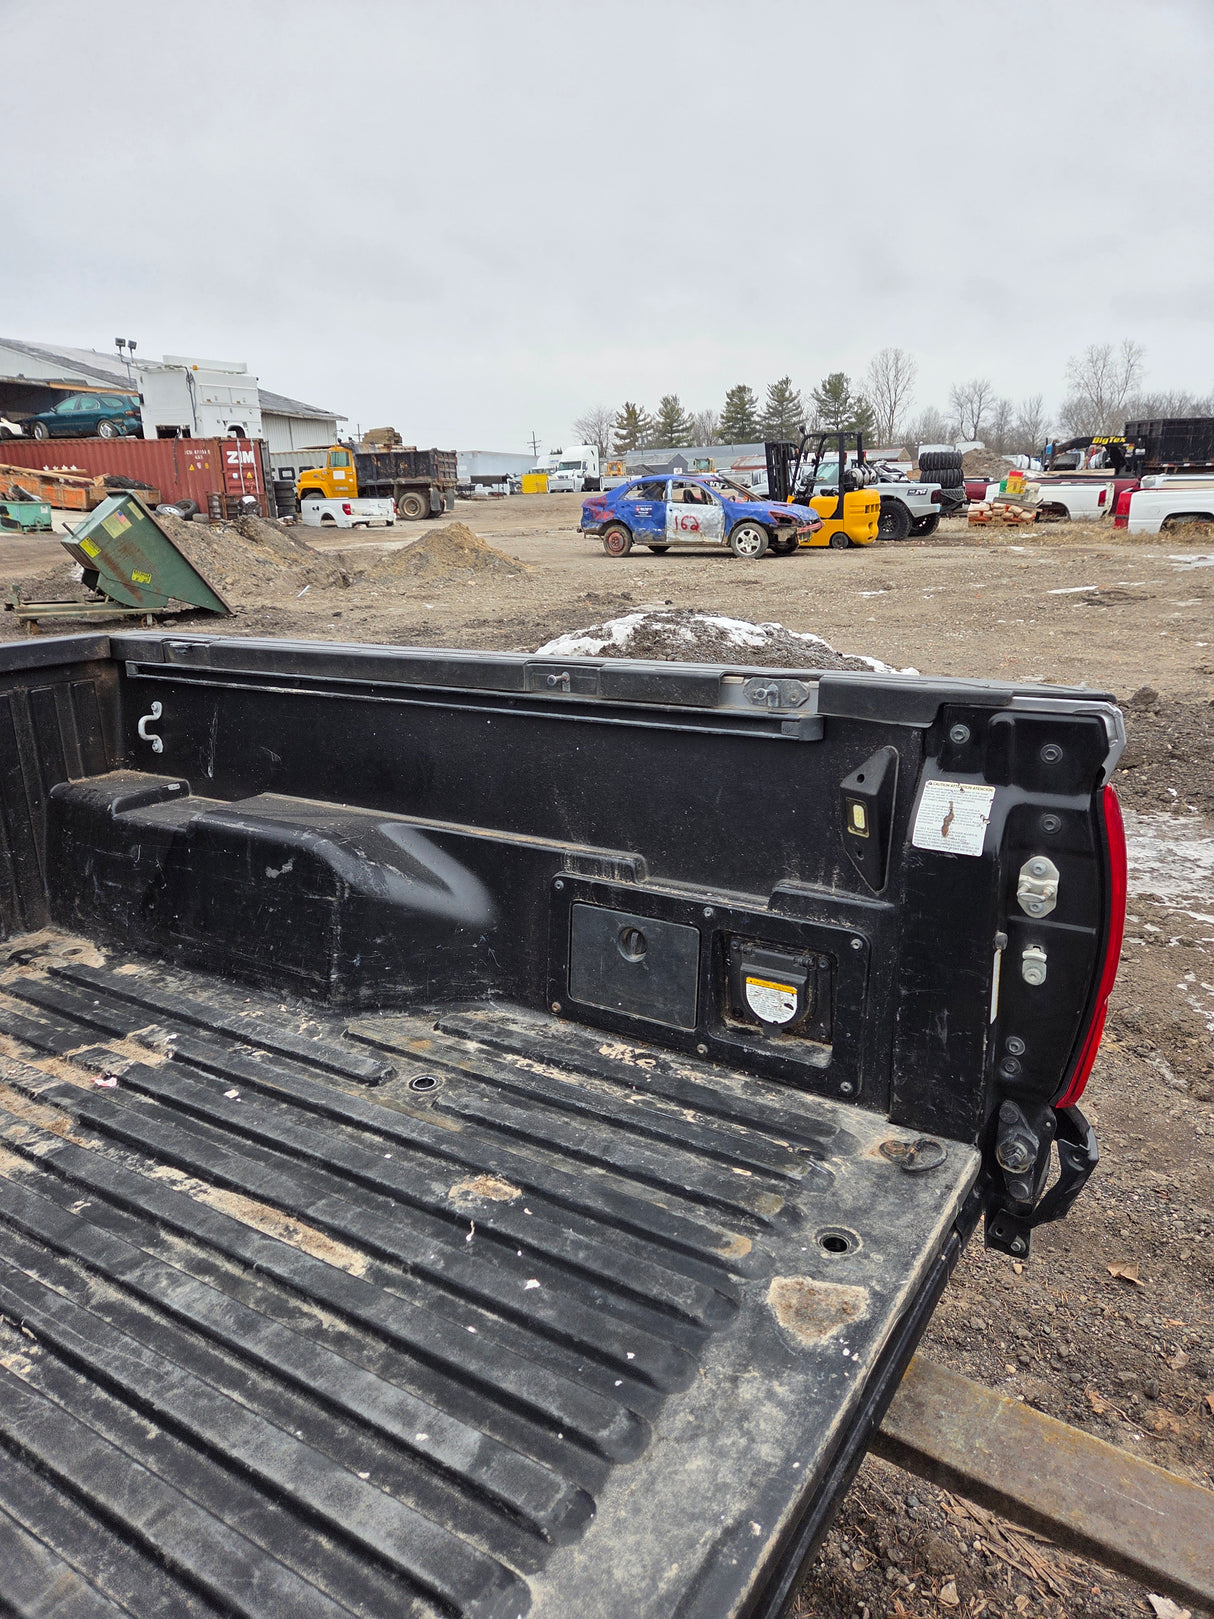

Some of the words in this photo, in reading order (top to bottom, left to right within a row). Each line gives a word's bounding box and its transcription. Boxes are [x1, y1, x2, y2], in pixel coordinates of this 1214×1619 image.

[1092, 436, 1126, 444] BigTex
[226, 451, 255, 463] ZIM
[675, 515, 700, 531] 162
